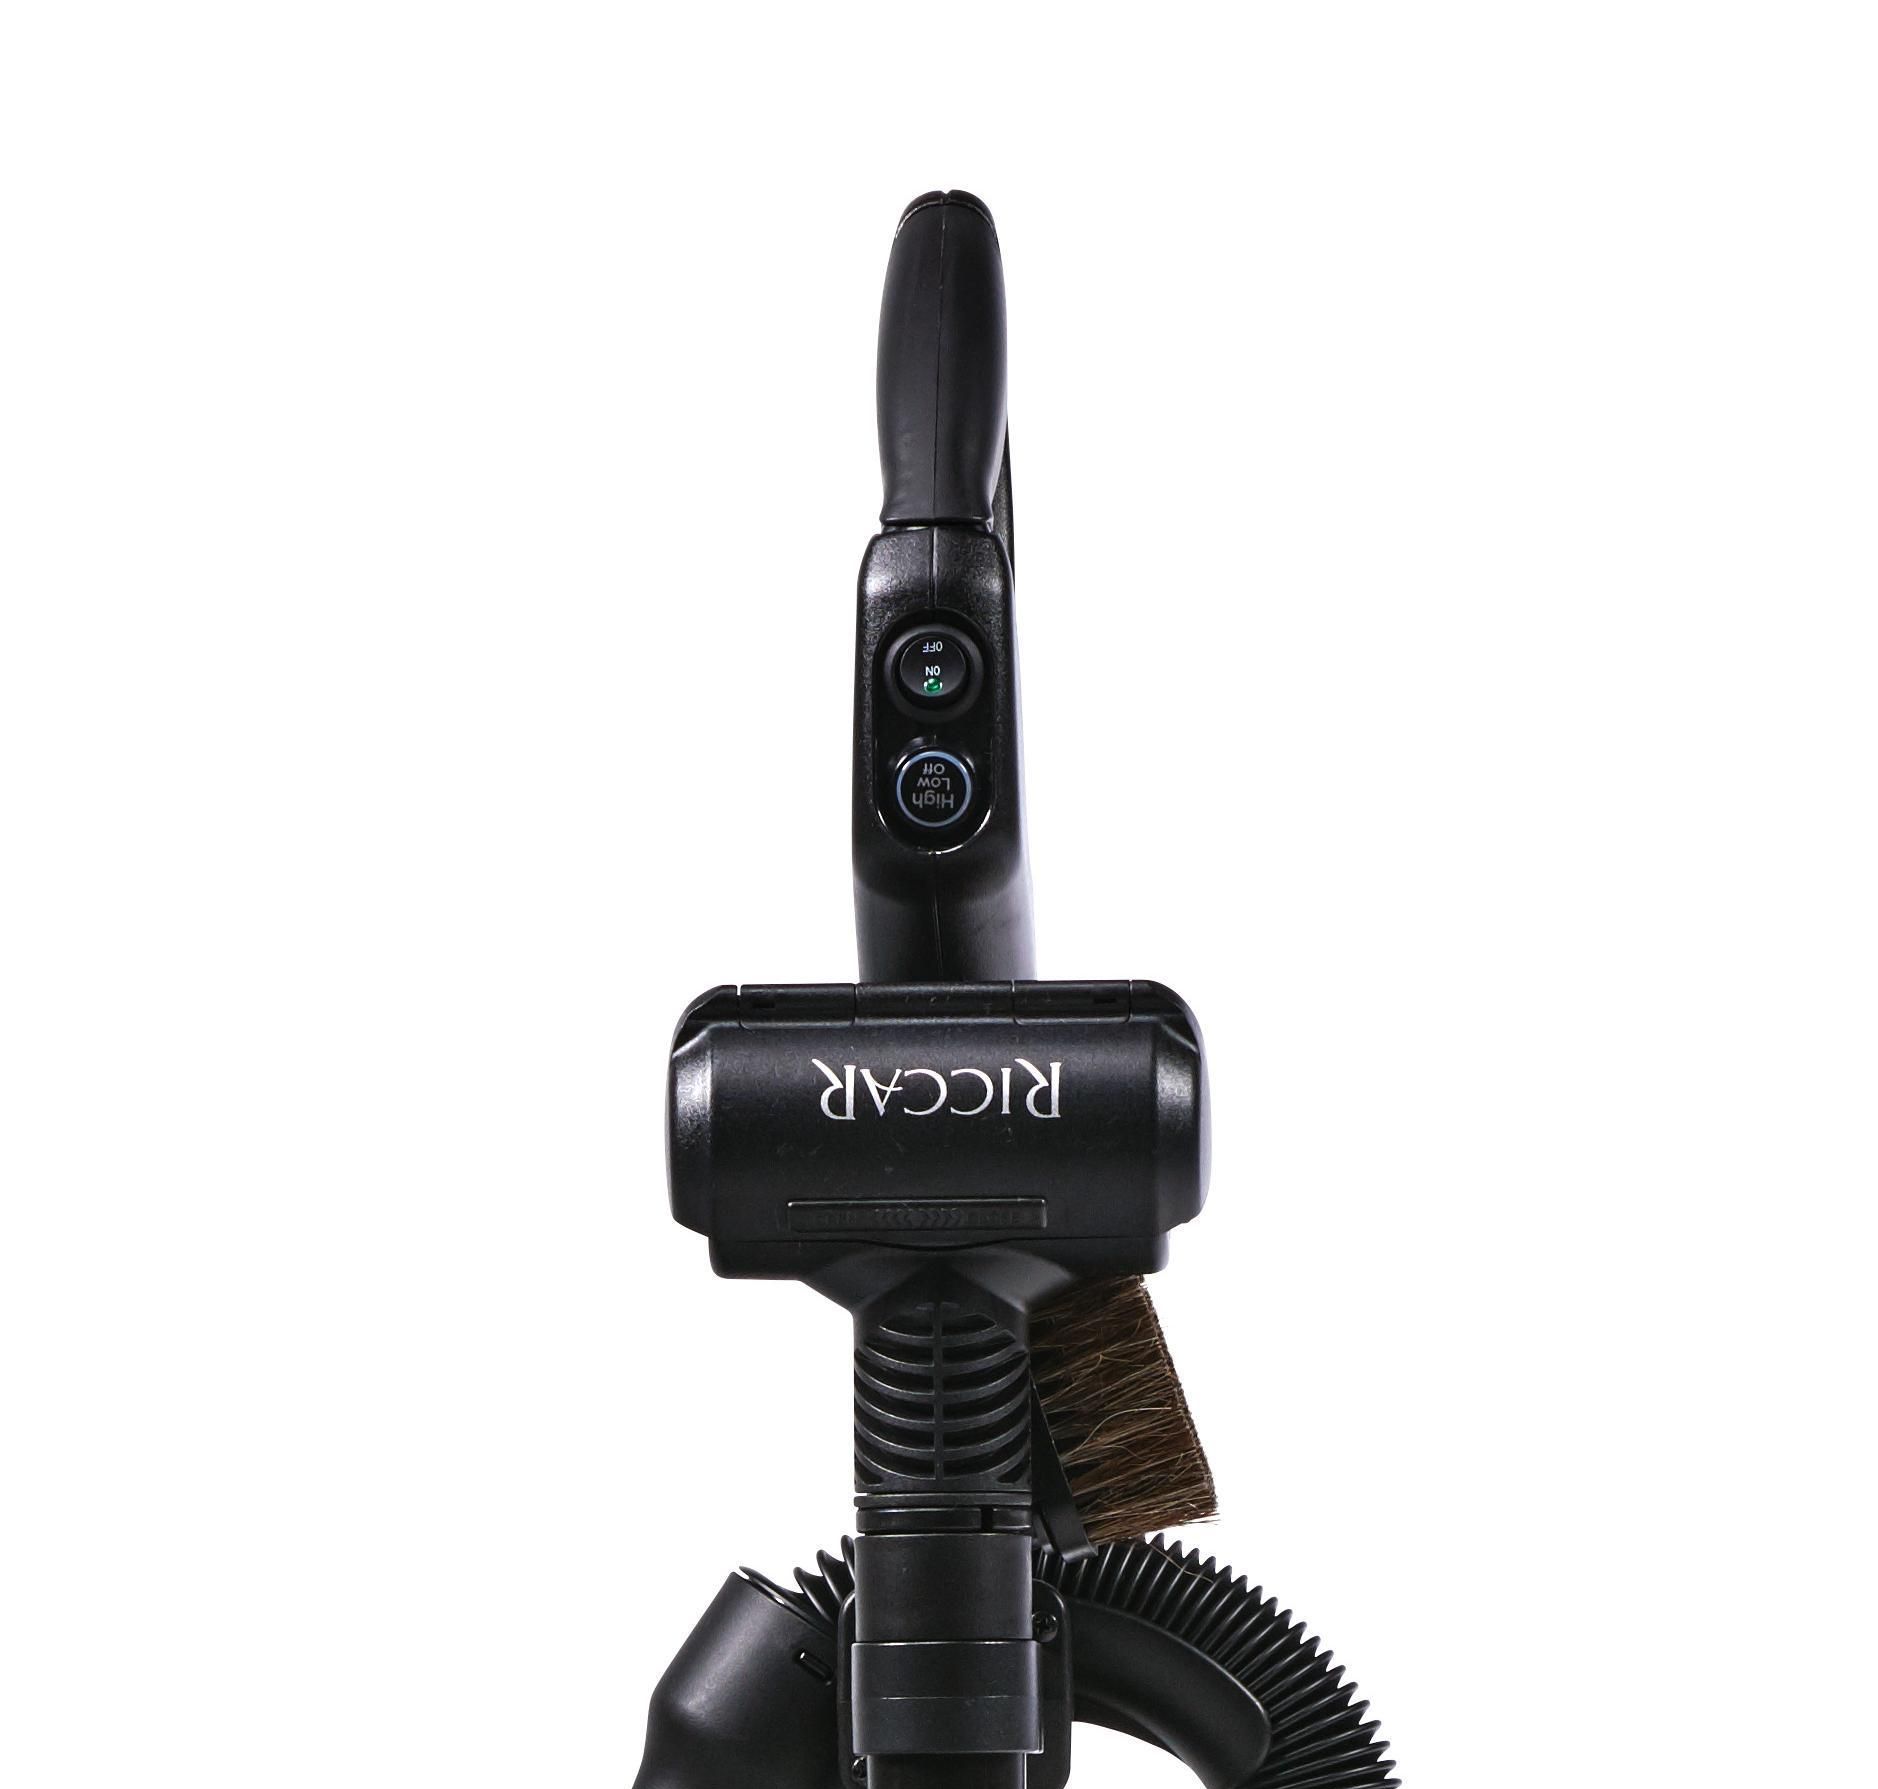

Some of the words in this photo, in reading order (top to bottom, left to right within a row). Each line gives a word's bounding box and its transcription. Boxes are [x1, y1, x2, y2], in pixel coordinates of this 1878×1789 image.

[922, 641, 943, 653] OFF
[925, 666, 941, 676] ON
[922, 763, 945, 774] Off
[917, 778, 950, 790] Low
[912, 790, 954, 808] High
[811, 1058, 1063, 1121] RICCAR
